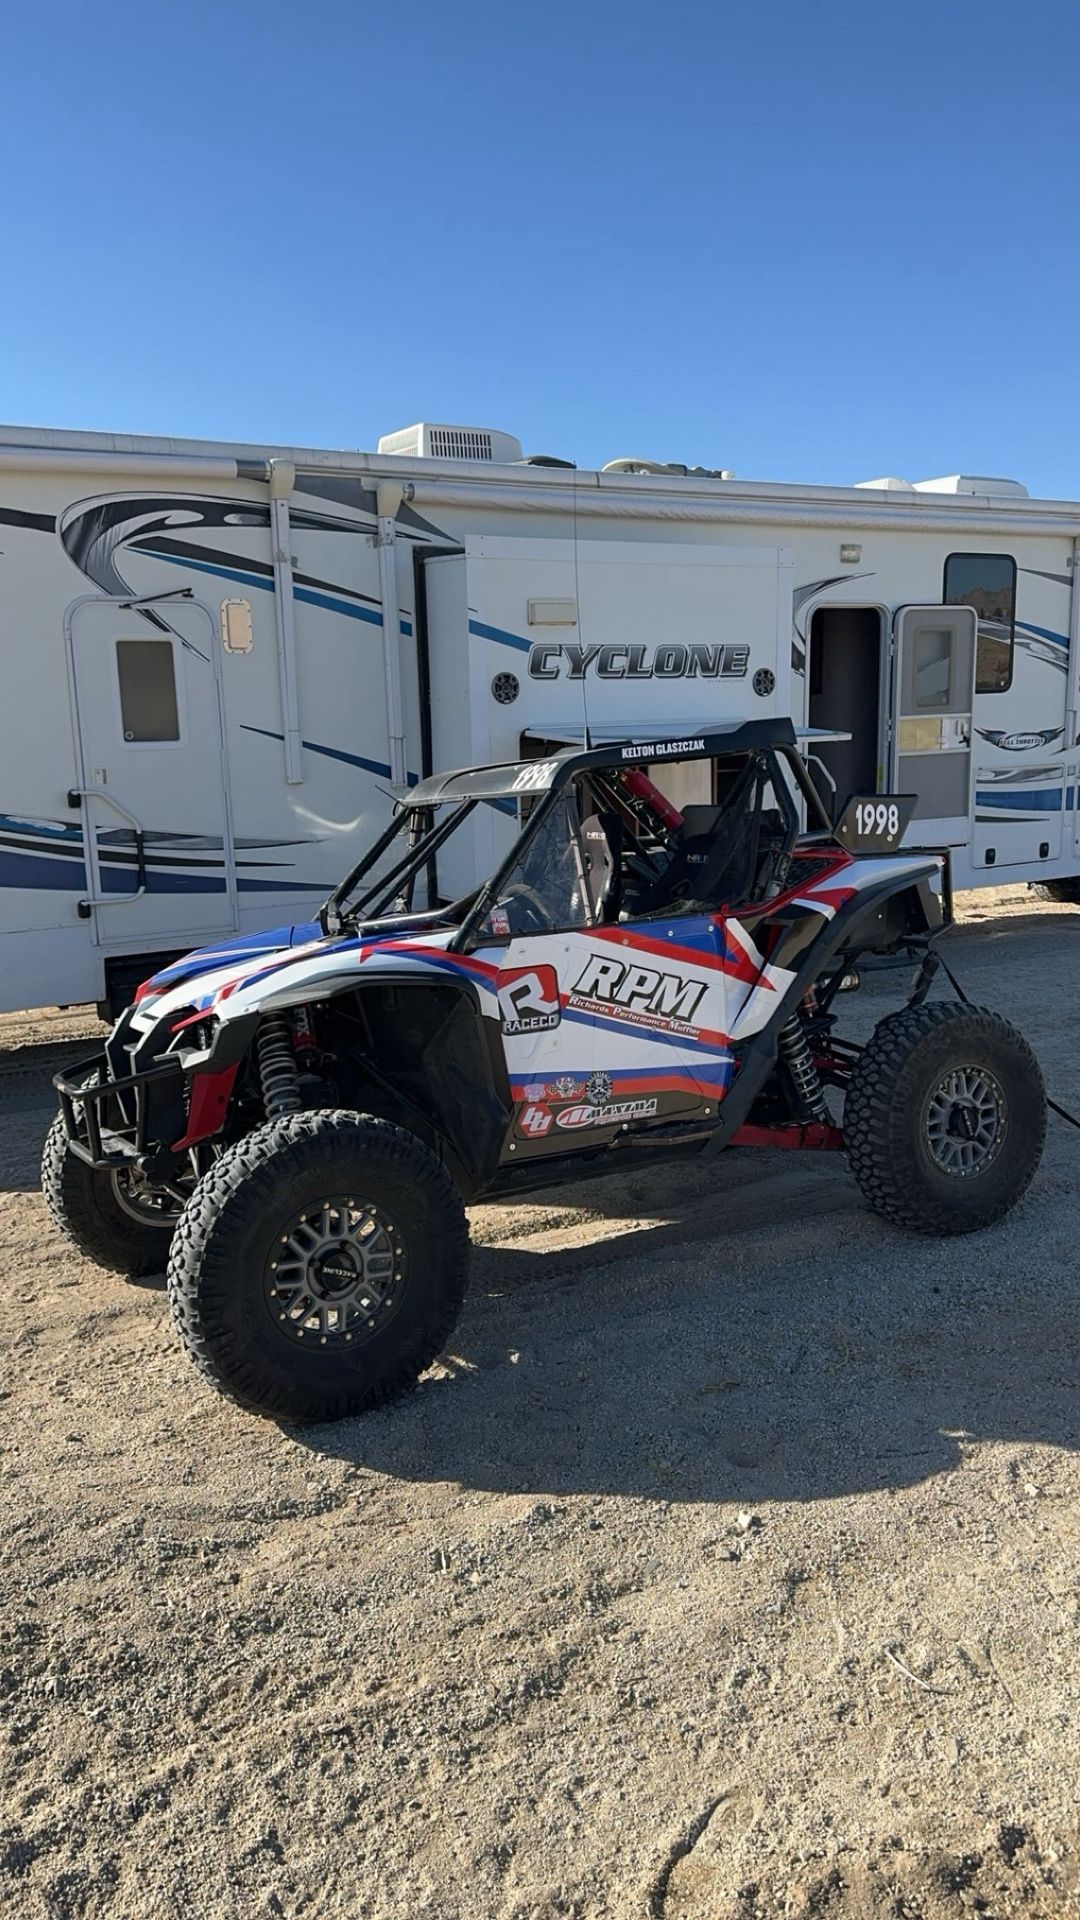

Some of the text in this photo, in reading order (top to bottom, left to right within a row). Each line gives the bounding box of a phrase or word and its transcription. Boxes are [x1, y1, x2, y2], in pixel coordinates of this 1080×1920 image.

[528, 644, 750, 679] CYCLONE
[621, 739, 705, 759] KELTON GLASZCZAK
[511, 762, 558, 789] 1998
[855, 803, 899, 835] 1998
[570, 953, 709, 1023] RPM
[503, 1014, 557, 1033] RACECO
[568, 995, 701, 1035] Richards Performance Muffler
